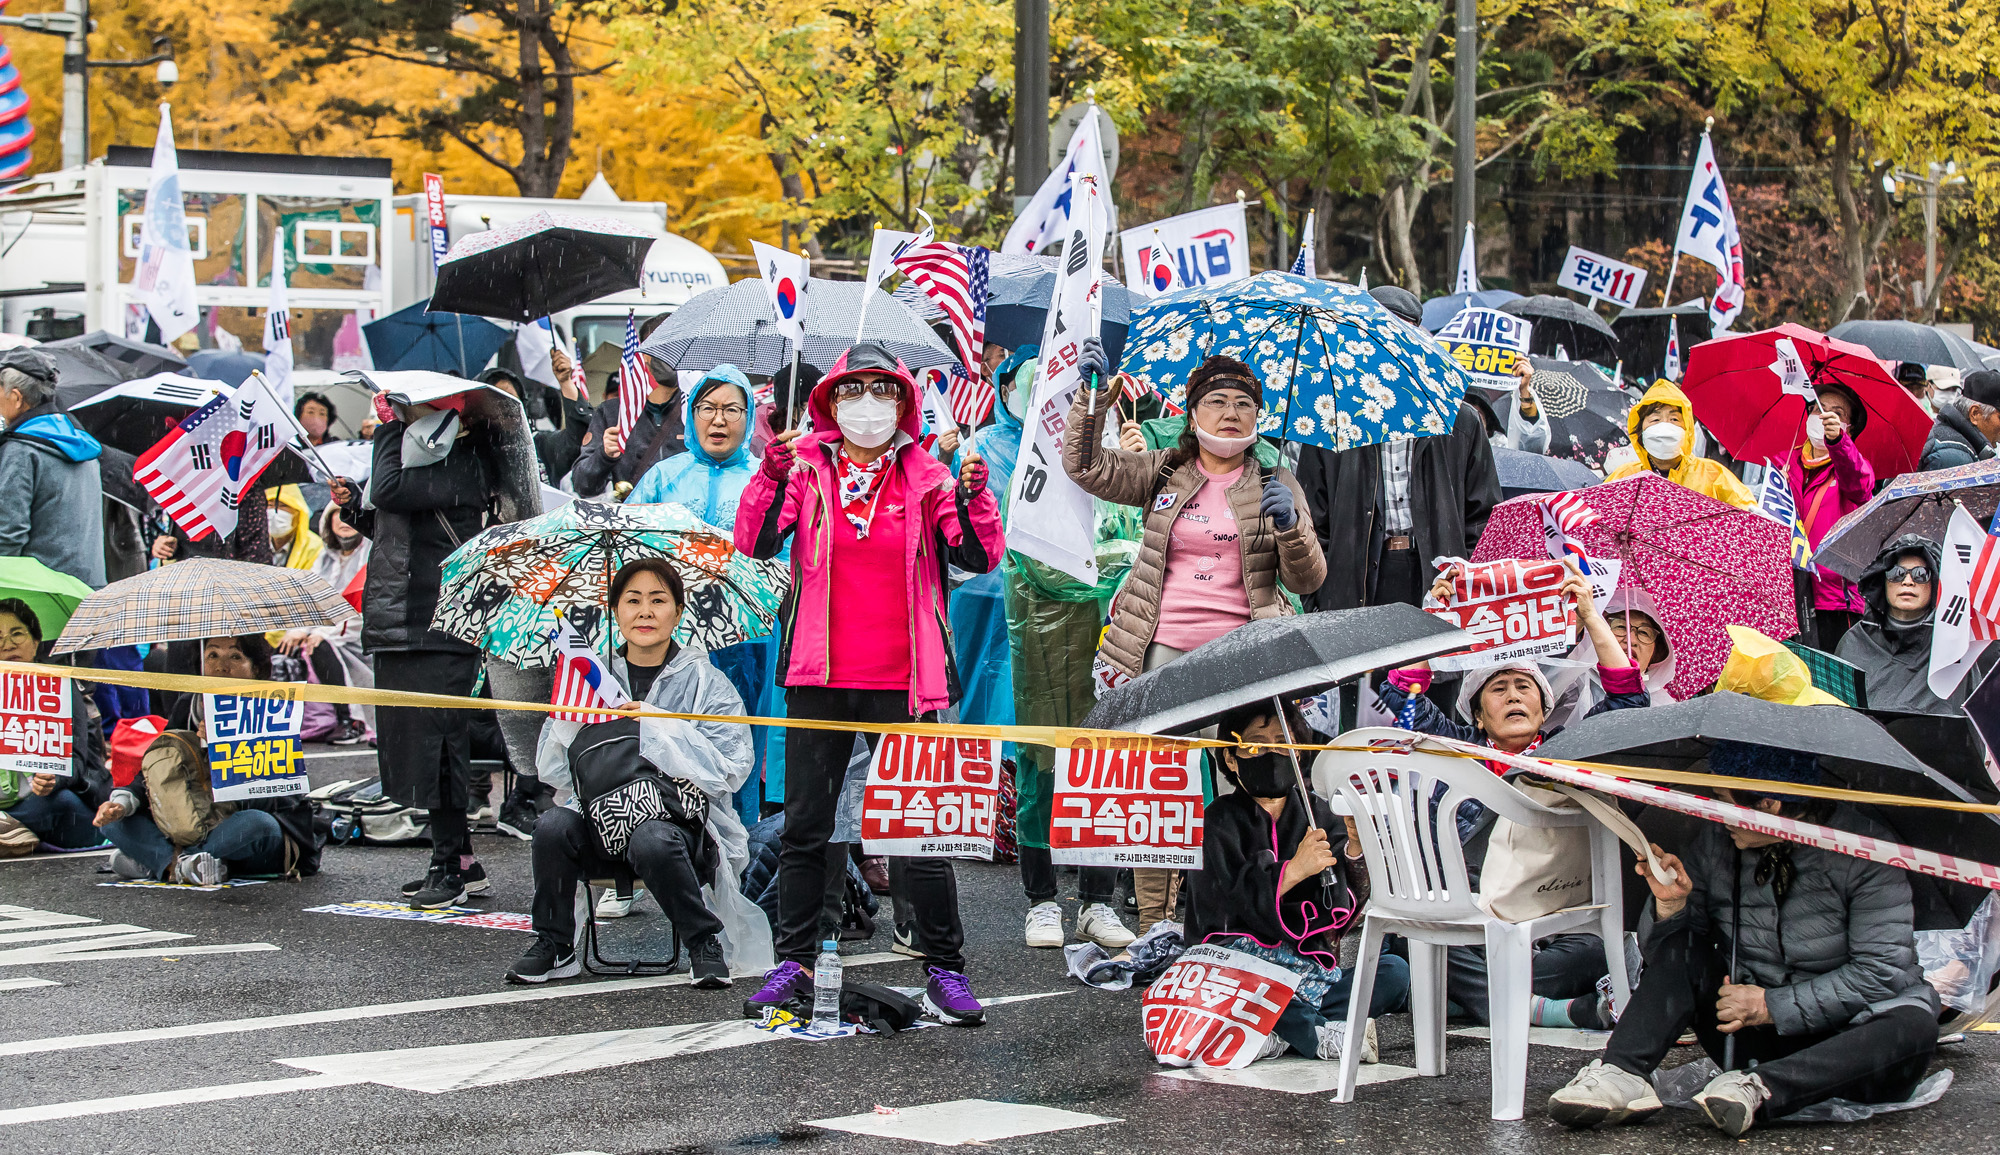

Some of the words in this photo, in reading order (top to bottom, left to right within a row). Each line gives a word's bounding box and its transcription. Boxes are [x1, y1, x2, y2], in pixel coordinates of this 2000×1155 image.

[645, 271, 712, 285] YUNDAI
[1573, 259, 1636, 301] 부산11
[1437, 341, 1522, 375] 속하라
[1494, 641, 1566, 662] #주사파척결범국민
[213, 687, 297, 738] 문재인
[211, 738, 304, 781] 구속하라
[877, 732, 994, 785] 이재명
[1067, 736, 1190, 791] 이재명
[864, 789, 998, 836] 구속하라
[1052, 797, 1204, 845] 구속하라
[1114, 853, 1196, 865] #주사파척결범국민대회
[1146, 965, 1282, 1026] 구속하라
[1145, 1008, 1246, 1067] 이재명
